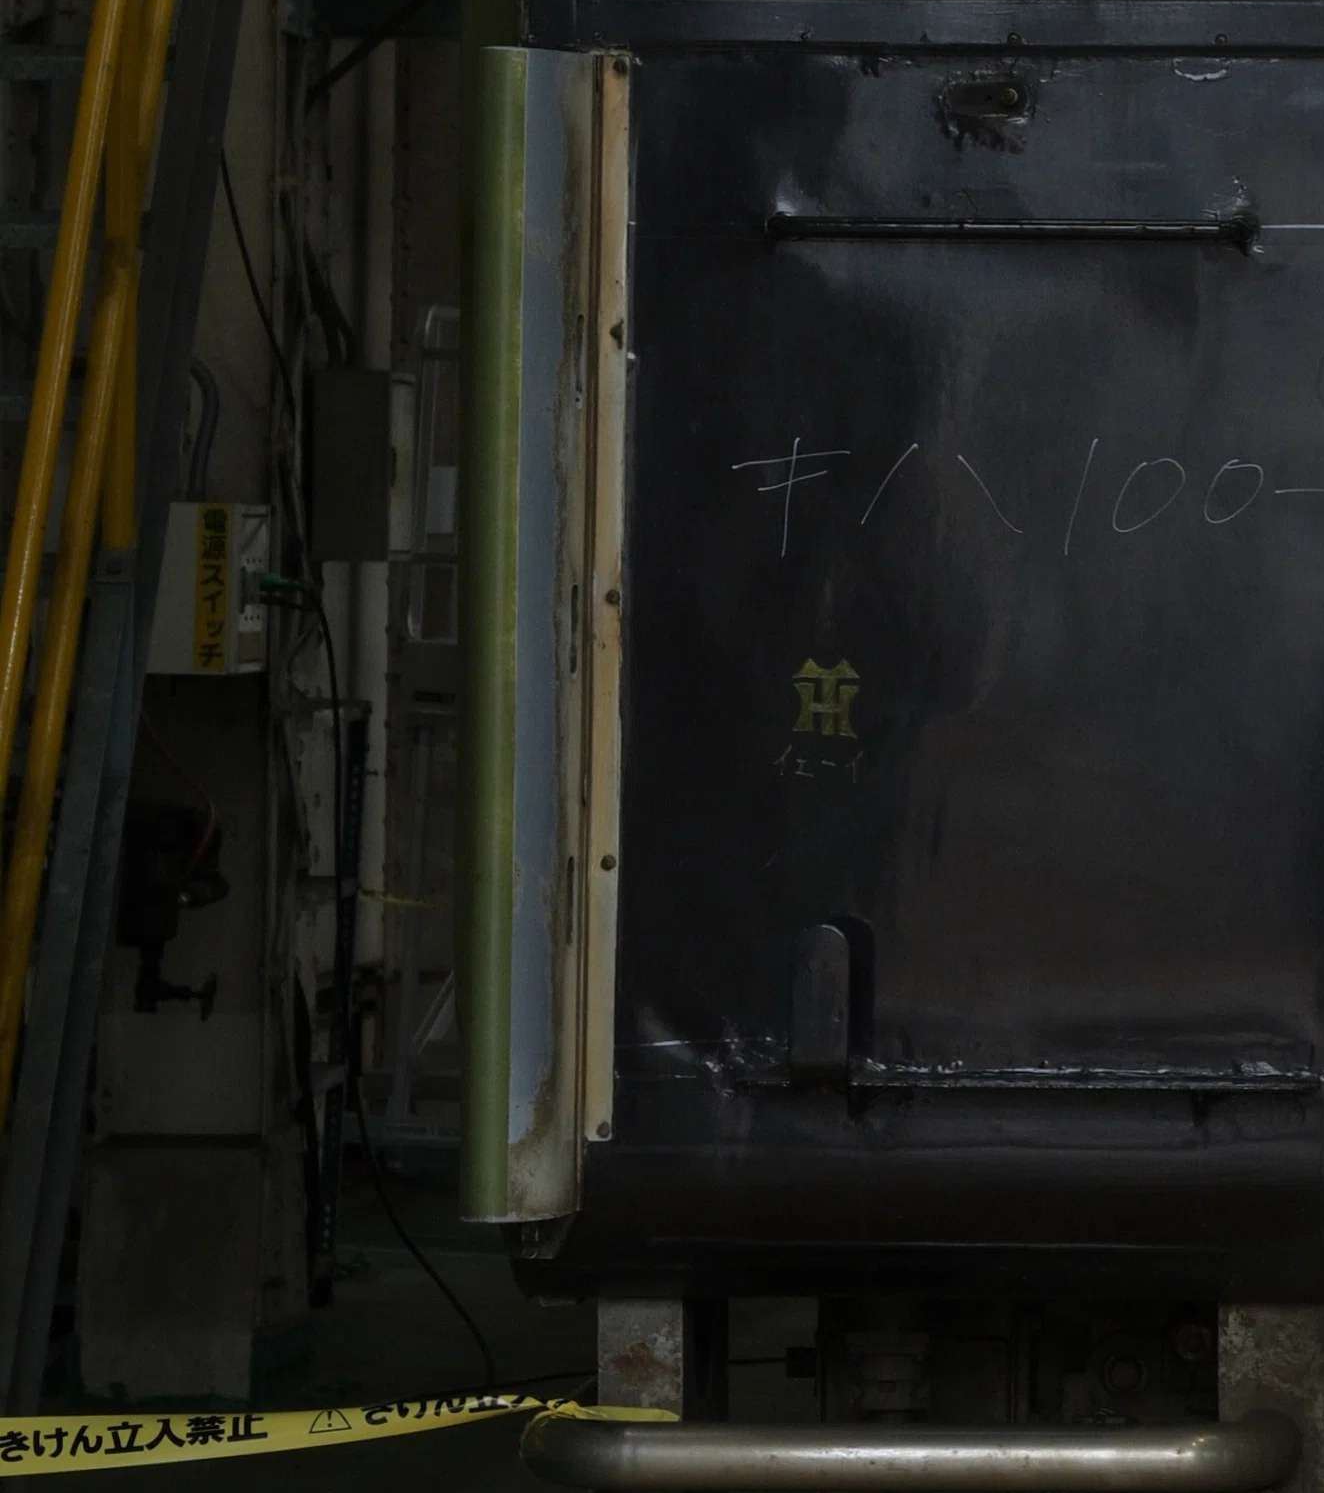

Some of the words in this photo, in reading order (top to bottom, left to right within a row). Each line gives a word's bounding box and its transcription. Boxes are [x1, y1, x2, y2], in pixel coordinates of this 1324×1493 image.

[199, 508, 228, 668] 電源スイッチ
[0, 1415, 268, 1462] きけん立入禁止
